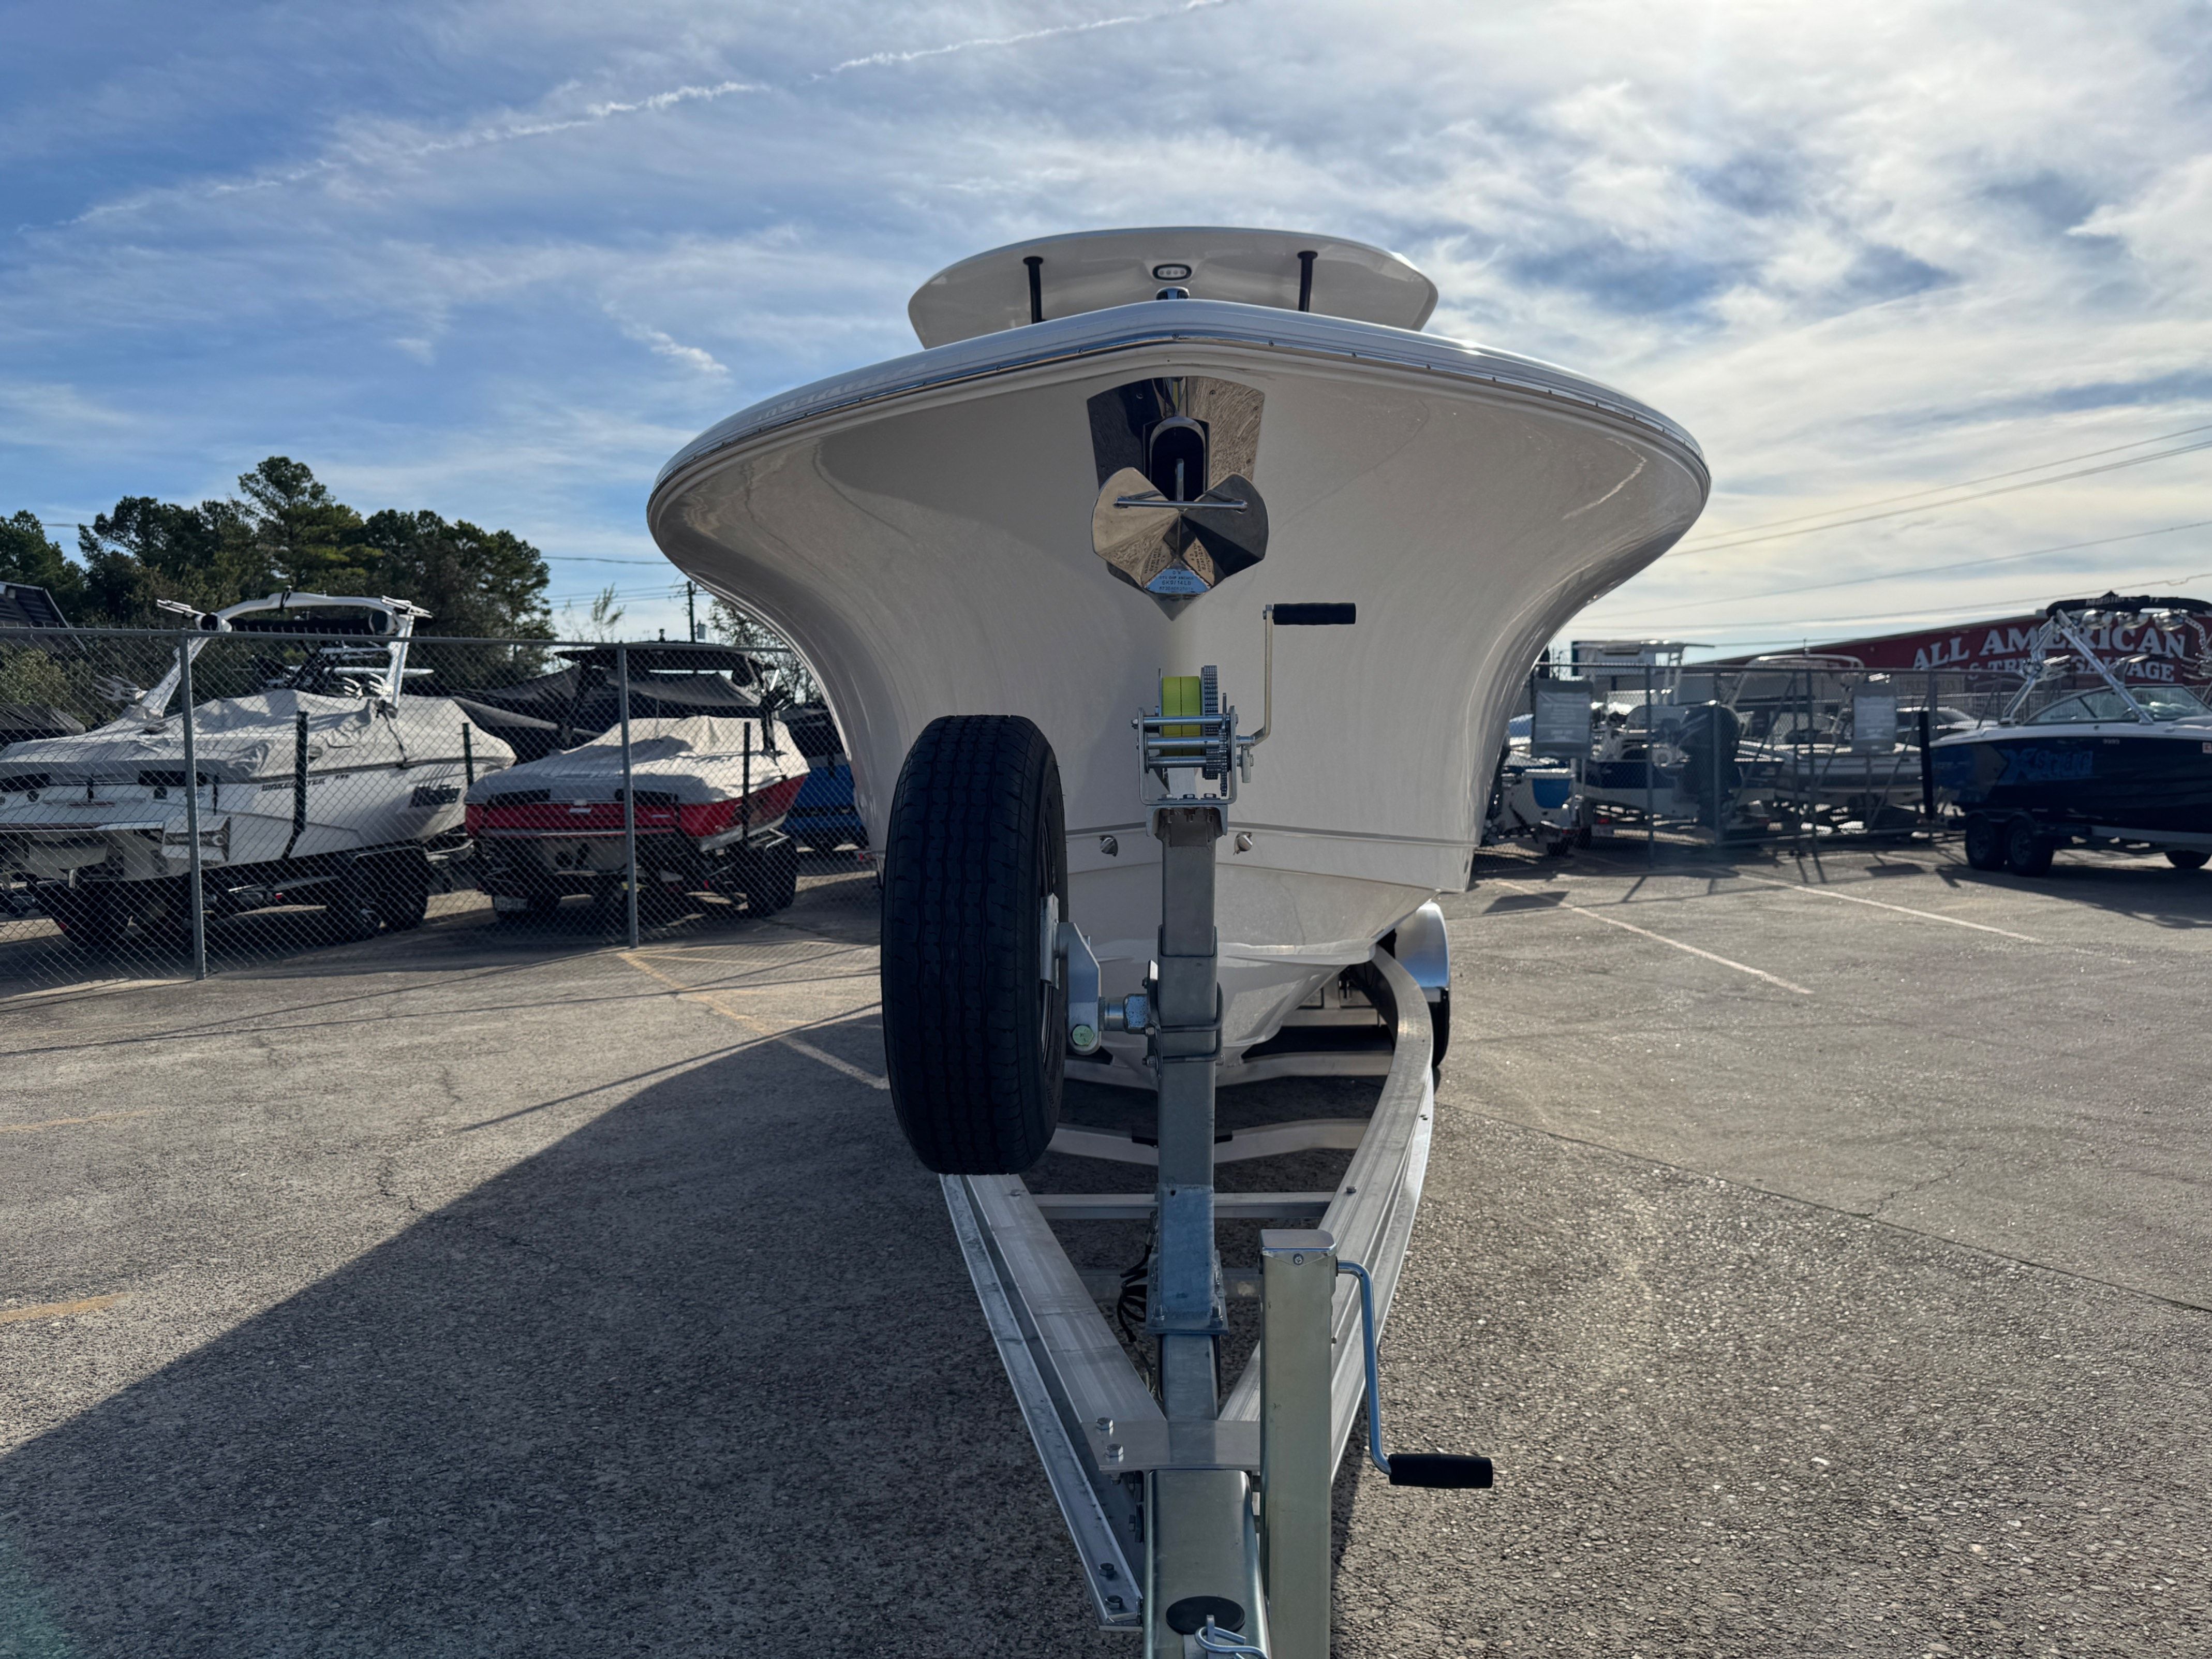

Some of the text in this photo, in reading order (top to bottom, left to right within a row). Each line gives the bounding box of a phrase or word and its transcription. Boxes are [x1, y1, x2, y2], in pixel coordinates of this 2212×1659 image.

[1913, 624, 2186, 671] ALL AMERICAN
[2071, 656, 2174, 682] SALAGE
